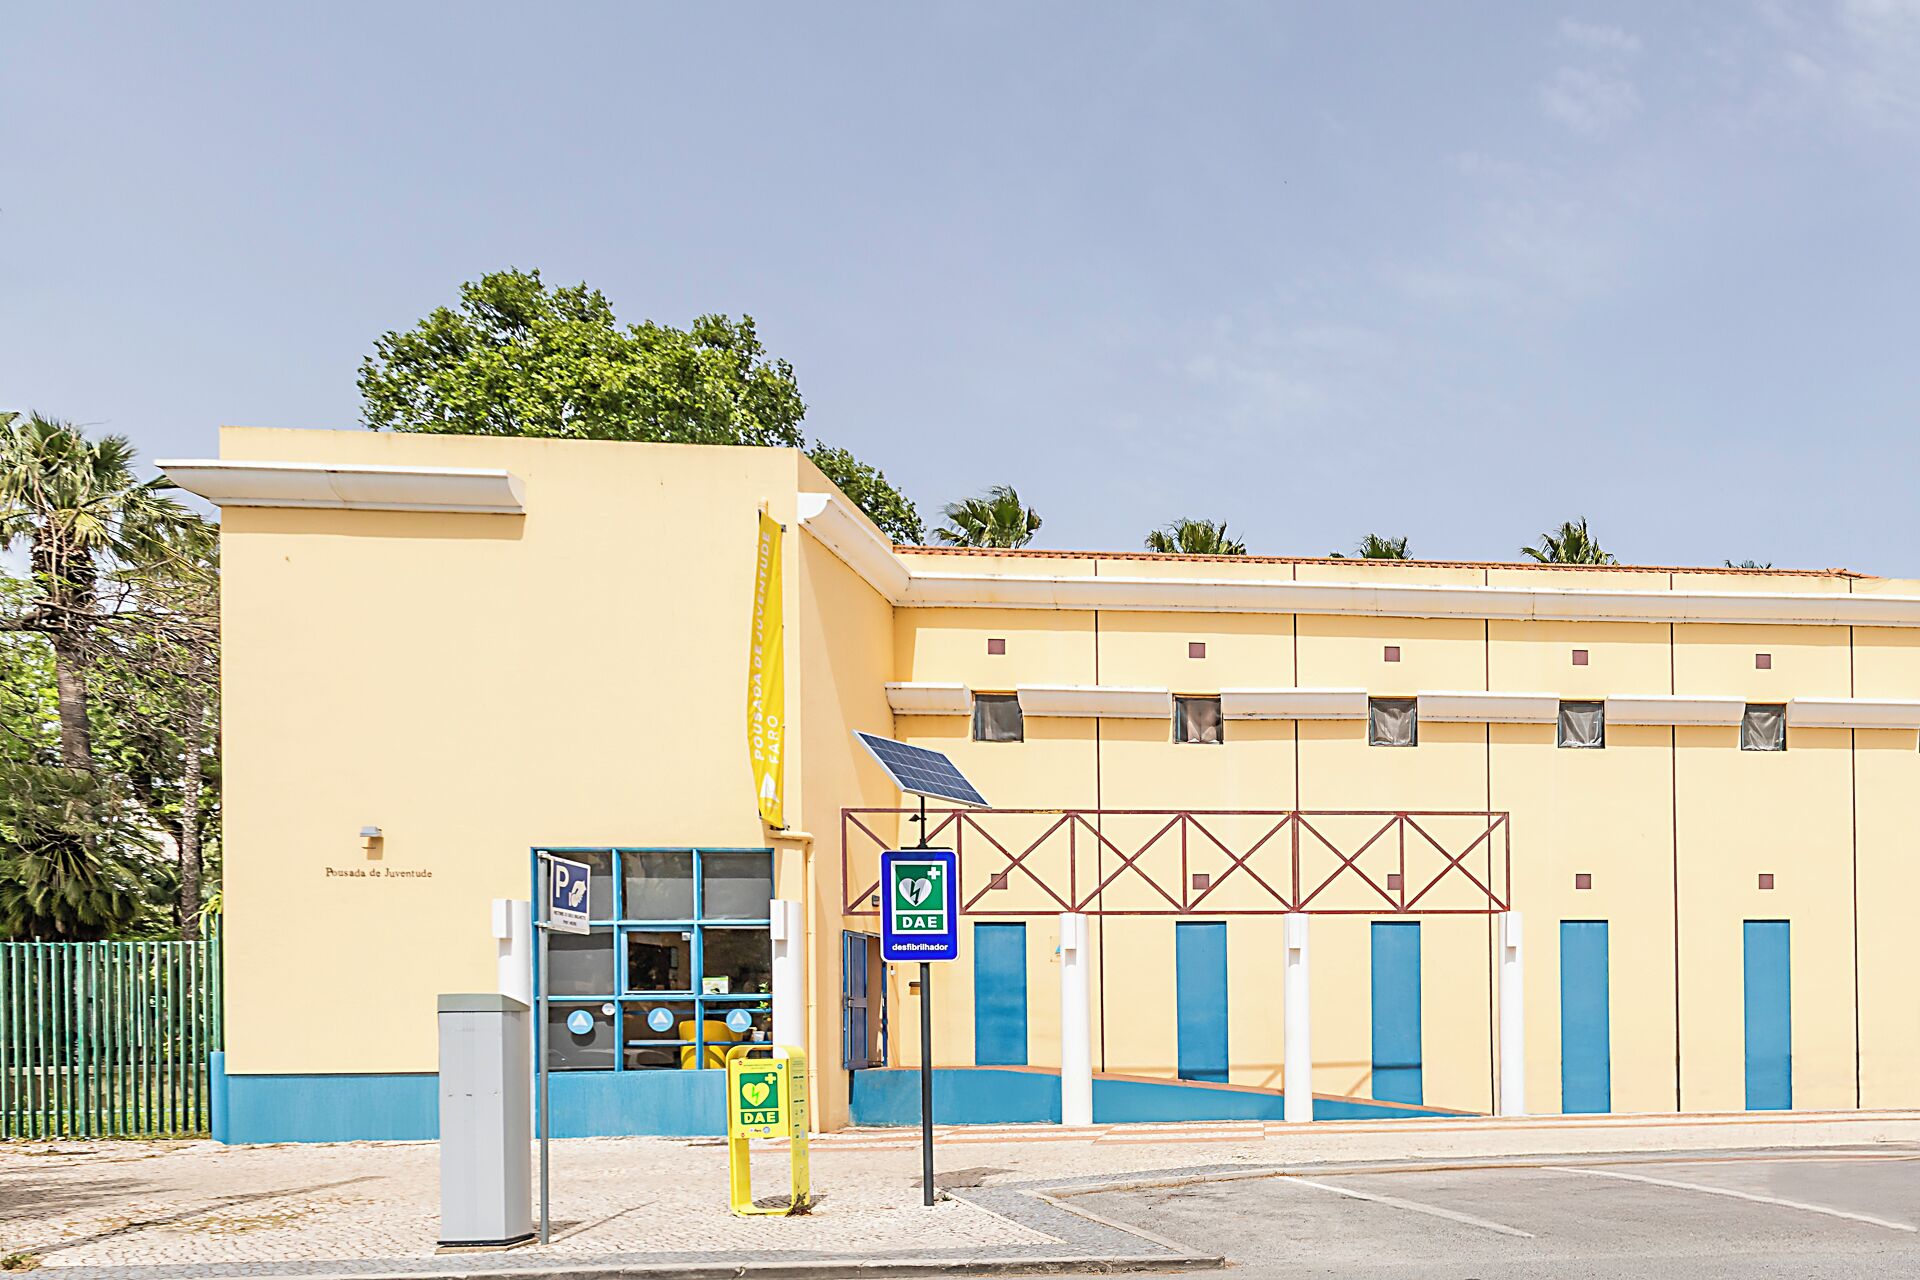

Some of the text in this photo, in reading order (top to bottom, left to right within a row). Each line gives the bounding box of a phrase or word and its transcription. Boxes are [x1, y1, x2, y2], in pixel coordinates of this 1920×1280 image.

[752, 531, 771, 761] POUSADA DE JUVENTUDE
[767, 715, 780, 764] FARO
[325, 866, 433, 878] Pousada de Juventude
[555, 864, 570, 898] P
[902, 916, 938, 928] DAE
[891, 943, 949, 951] desfibrilhador
[743, 1111, 776, 1124] DAE
